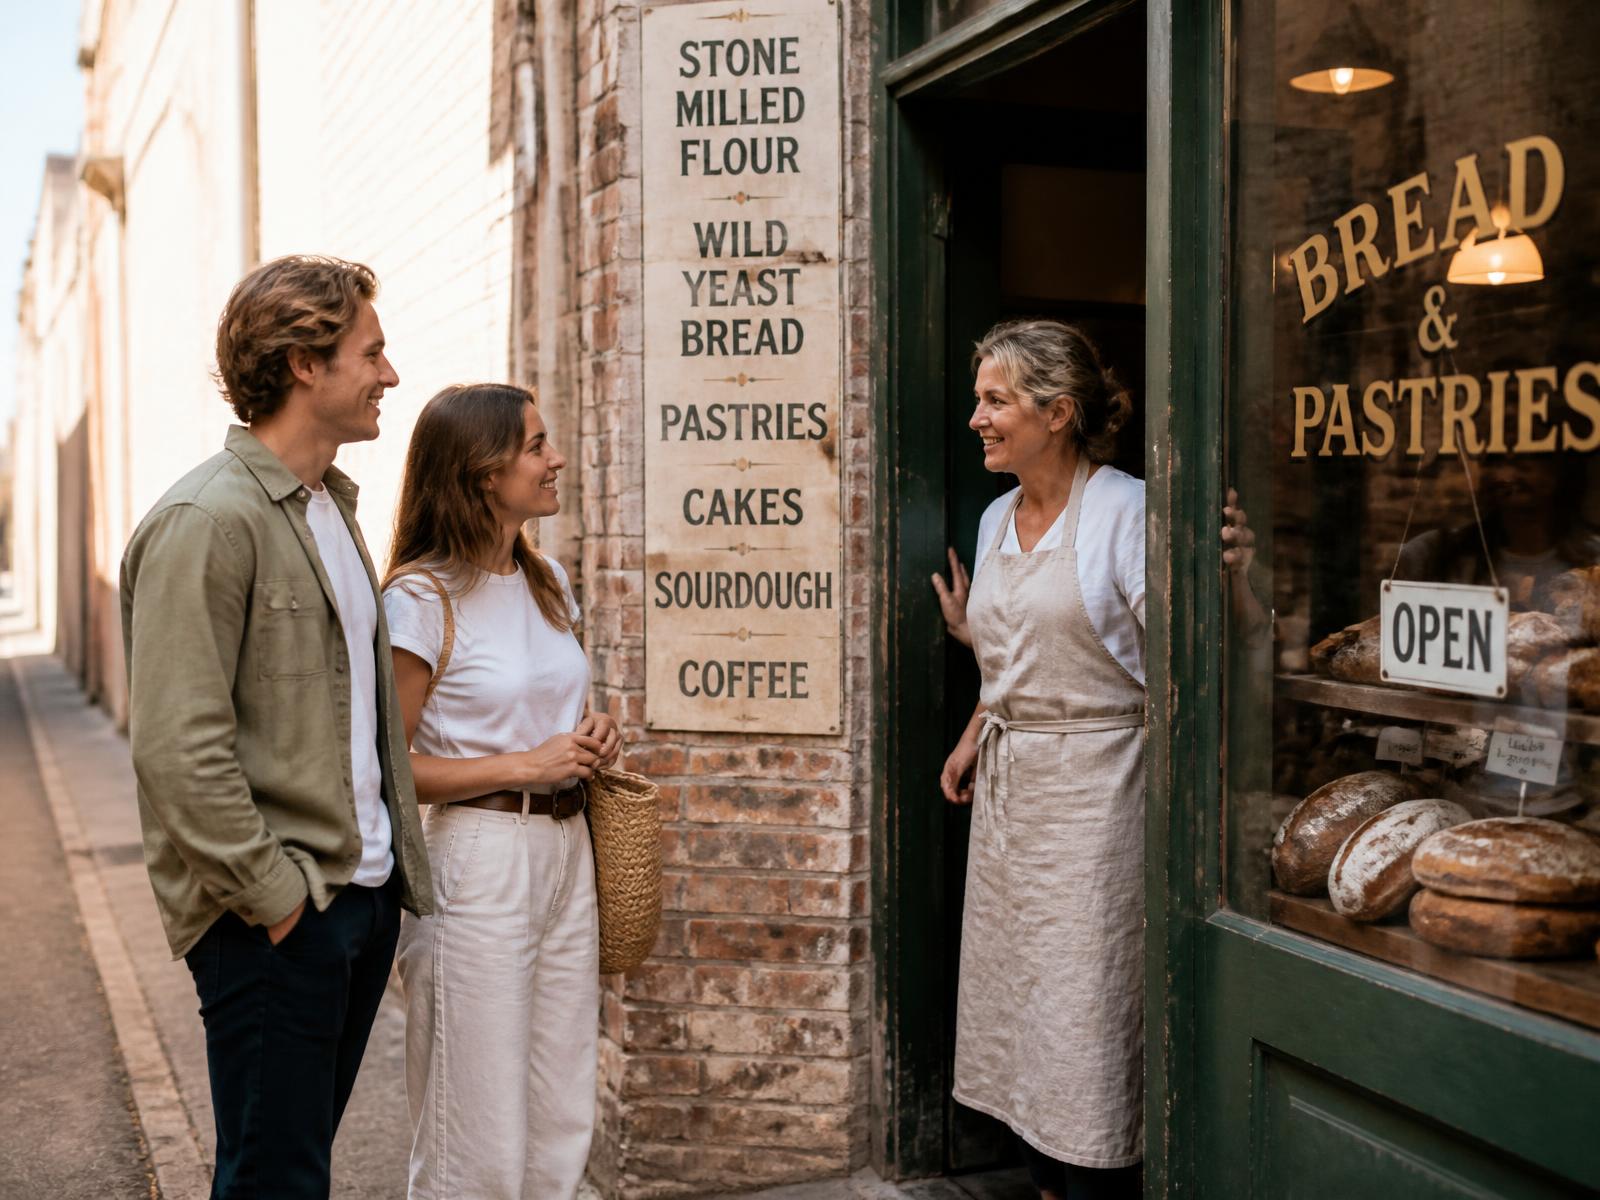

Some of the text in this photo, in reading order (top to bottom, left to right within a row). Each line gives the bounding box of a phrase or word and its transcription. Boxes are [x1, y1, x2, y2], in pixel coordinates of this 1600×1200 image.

[679, 37, 801, 79] STONE
[676, 87, 805, 128] MILLED
[680, 136, 801, 176] FLOUR
[693, 220, 789, 259] WILD
[1289, 135, 1566, 324] BREAD
[681, 268, 801, 307] YEAST
[681, 318, 805, 357] BREAD
[1418, 284, 1459, 352] &
[660, 402, 828, 441] PASTRIES
[1290, 361, 1600, 458] PASTRIES
[683, 488, 804, 526] CAKES
[655, 571, 833, 610] SOURDOUGH
[1392, 601, 1493, 673] OPEN
[678, 659, 810, 699] COFFEE
